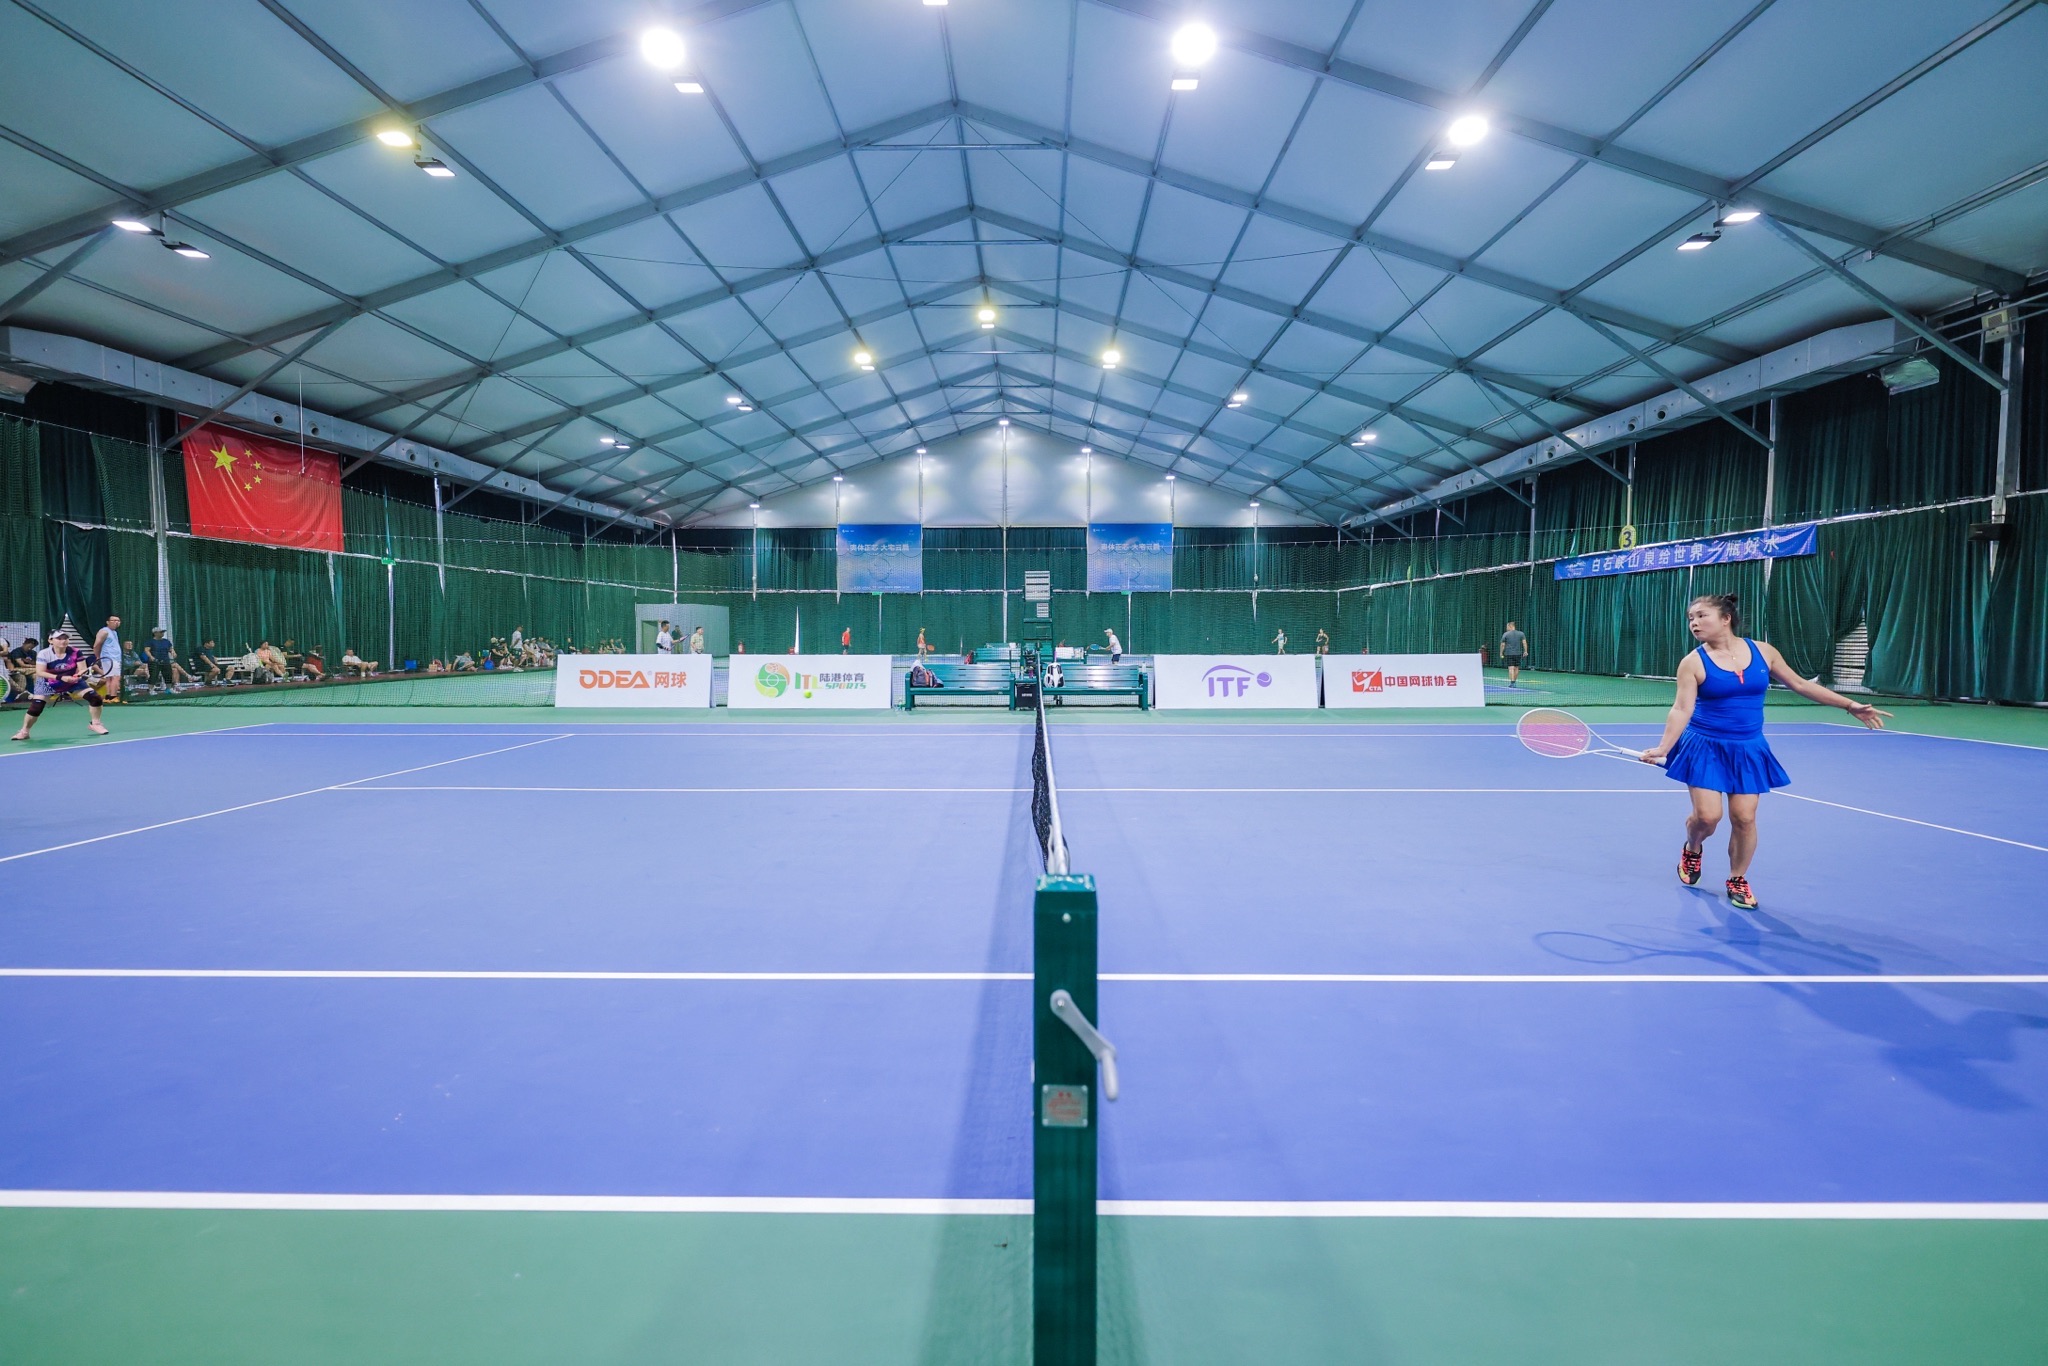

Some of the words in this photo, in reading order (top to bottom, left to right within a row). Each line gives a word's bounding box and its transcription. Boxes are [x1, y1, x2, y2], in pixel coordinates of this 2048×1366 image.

[1623, 531, 1632, 548] 3
[579, 670, 650, 689] ODEA
[654, 671, 687, 688] 网球
[819, 672, 865, 683] 陆港体育
[1385, 675, 1457, 687] 中国网球协会
[825, 682, 867, 690] SPORTS
[1208, 677, 1251, 698] ITF
